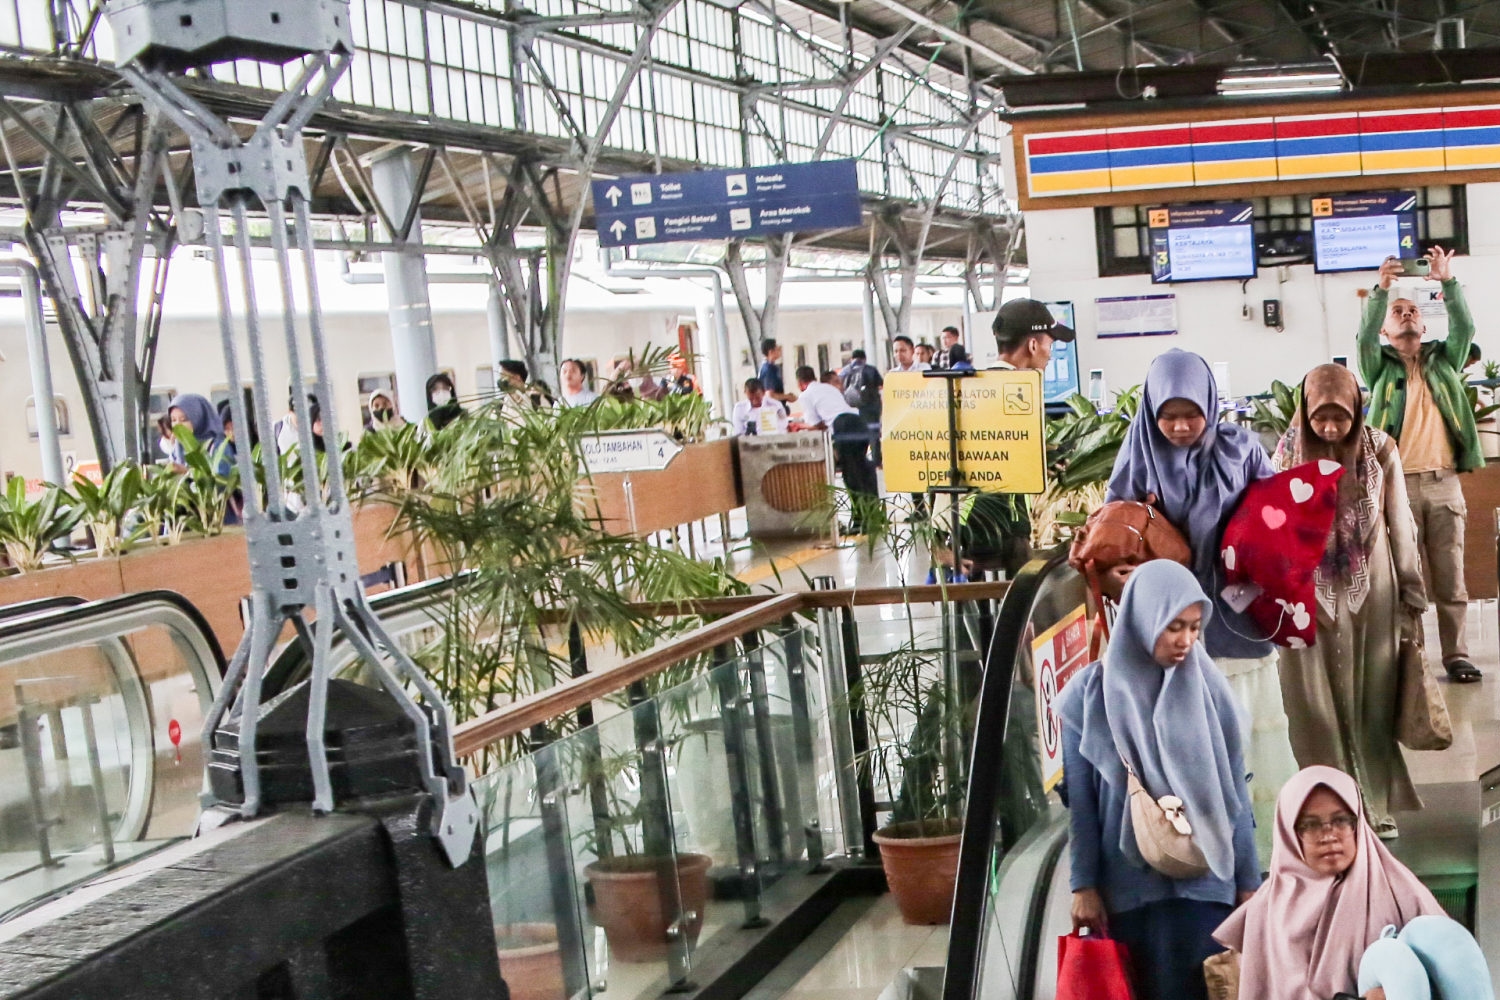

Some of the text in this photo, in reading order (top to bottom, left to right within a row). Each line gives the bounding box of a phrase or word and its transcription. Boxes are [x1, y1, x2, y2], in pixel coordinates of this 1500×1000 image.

[1400, 235, 1413, 249] 4
[1157, 252, 1169, 265] 3
[890, 430, 933, 441] MOHON
[970, 430, 1029, 441] MENARUH
[602, 440, 643, 453] TAMBAHAN
[957, 450, 1009, 461] BAWAAN
[969, 471, 1003, 481] ANDA
